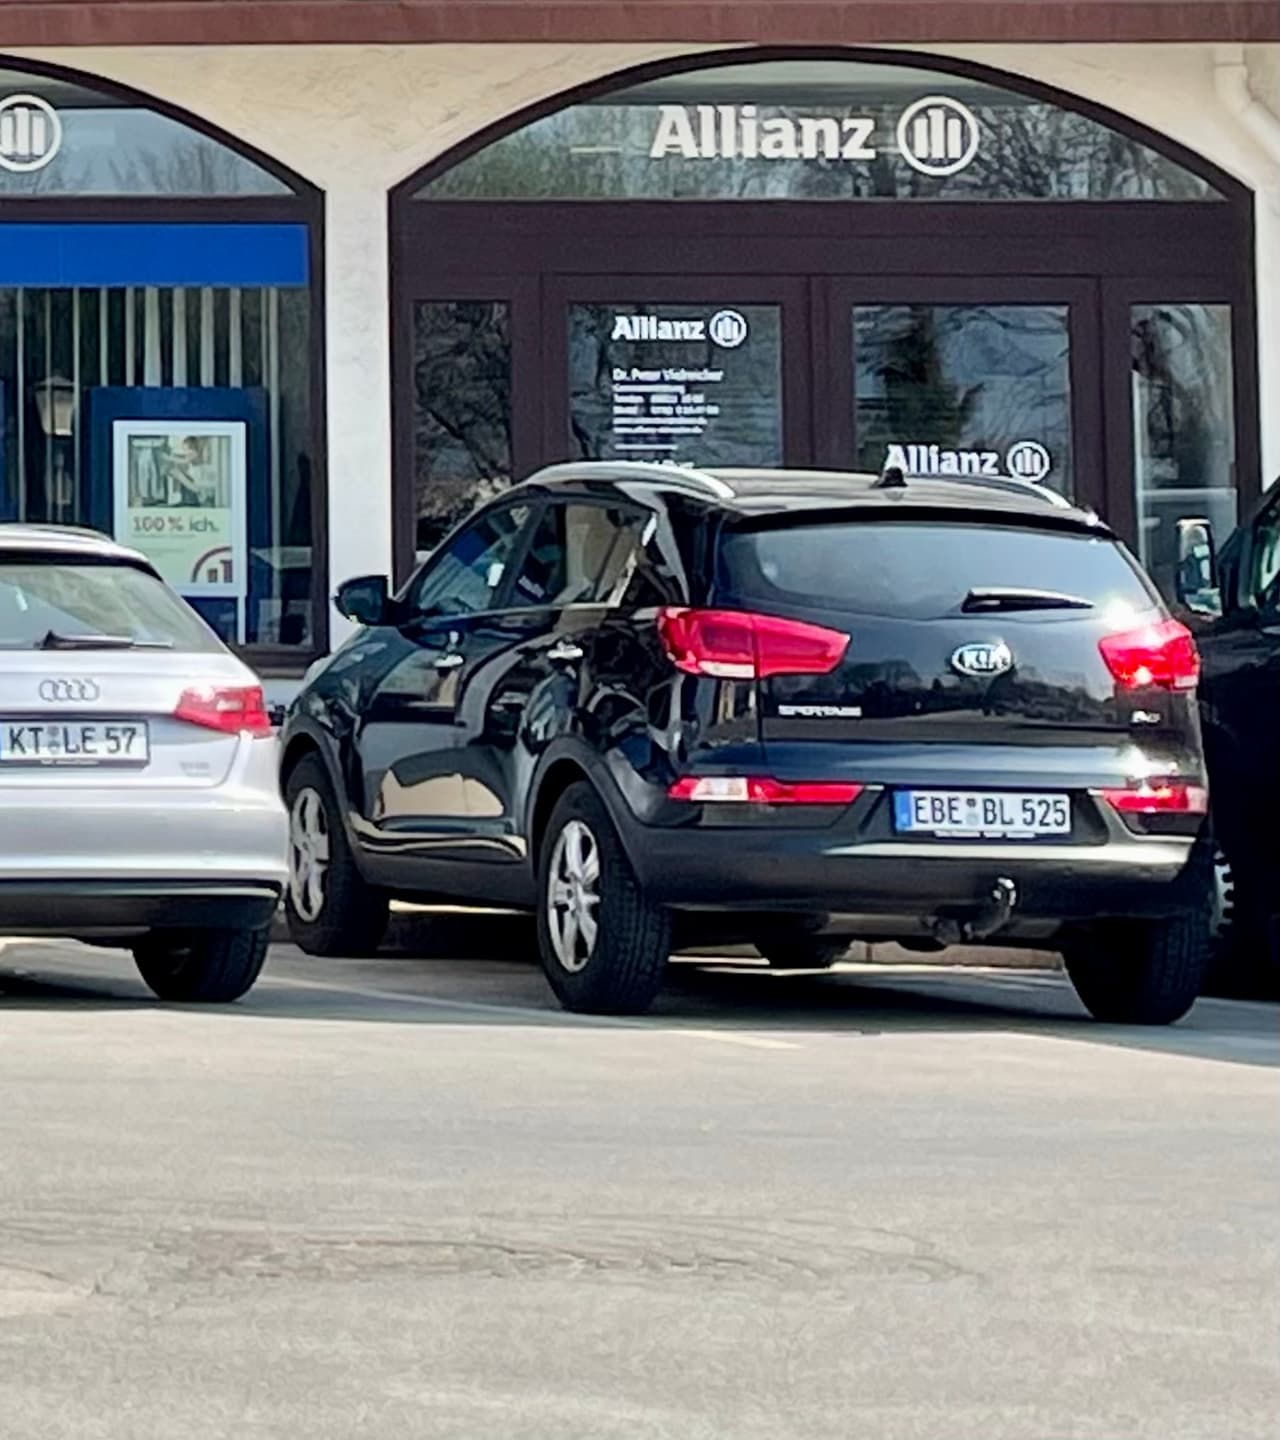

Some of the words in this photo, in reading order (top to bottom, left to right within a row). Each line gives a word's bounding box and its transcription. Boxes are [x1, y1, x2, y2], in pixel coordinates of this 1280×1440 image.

[649, 104, 877, 160] Allianz
[611, 315, 707, 341] Allianz
[883, 443, 1000, 475] Allianz
[133, 516, 165, 532] 100
[168, 516, 185, 532] %
[8, 726, 44, 755] KT
[62, 726, 98, 755] LE
[105, 726, 137, 755] 57
[913, 795, 963, 825] EBE
[982, 797, 1015, 826] BL
[1021, 797, 1067, 828] 525
